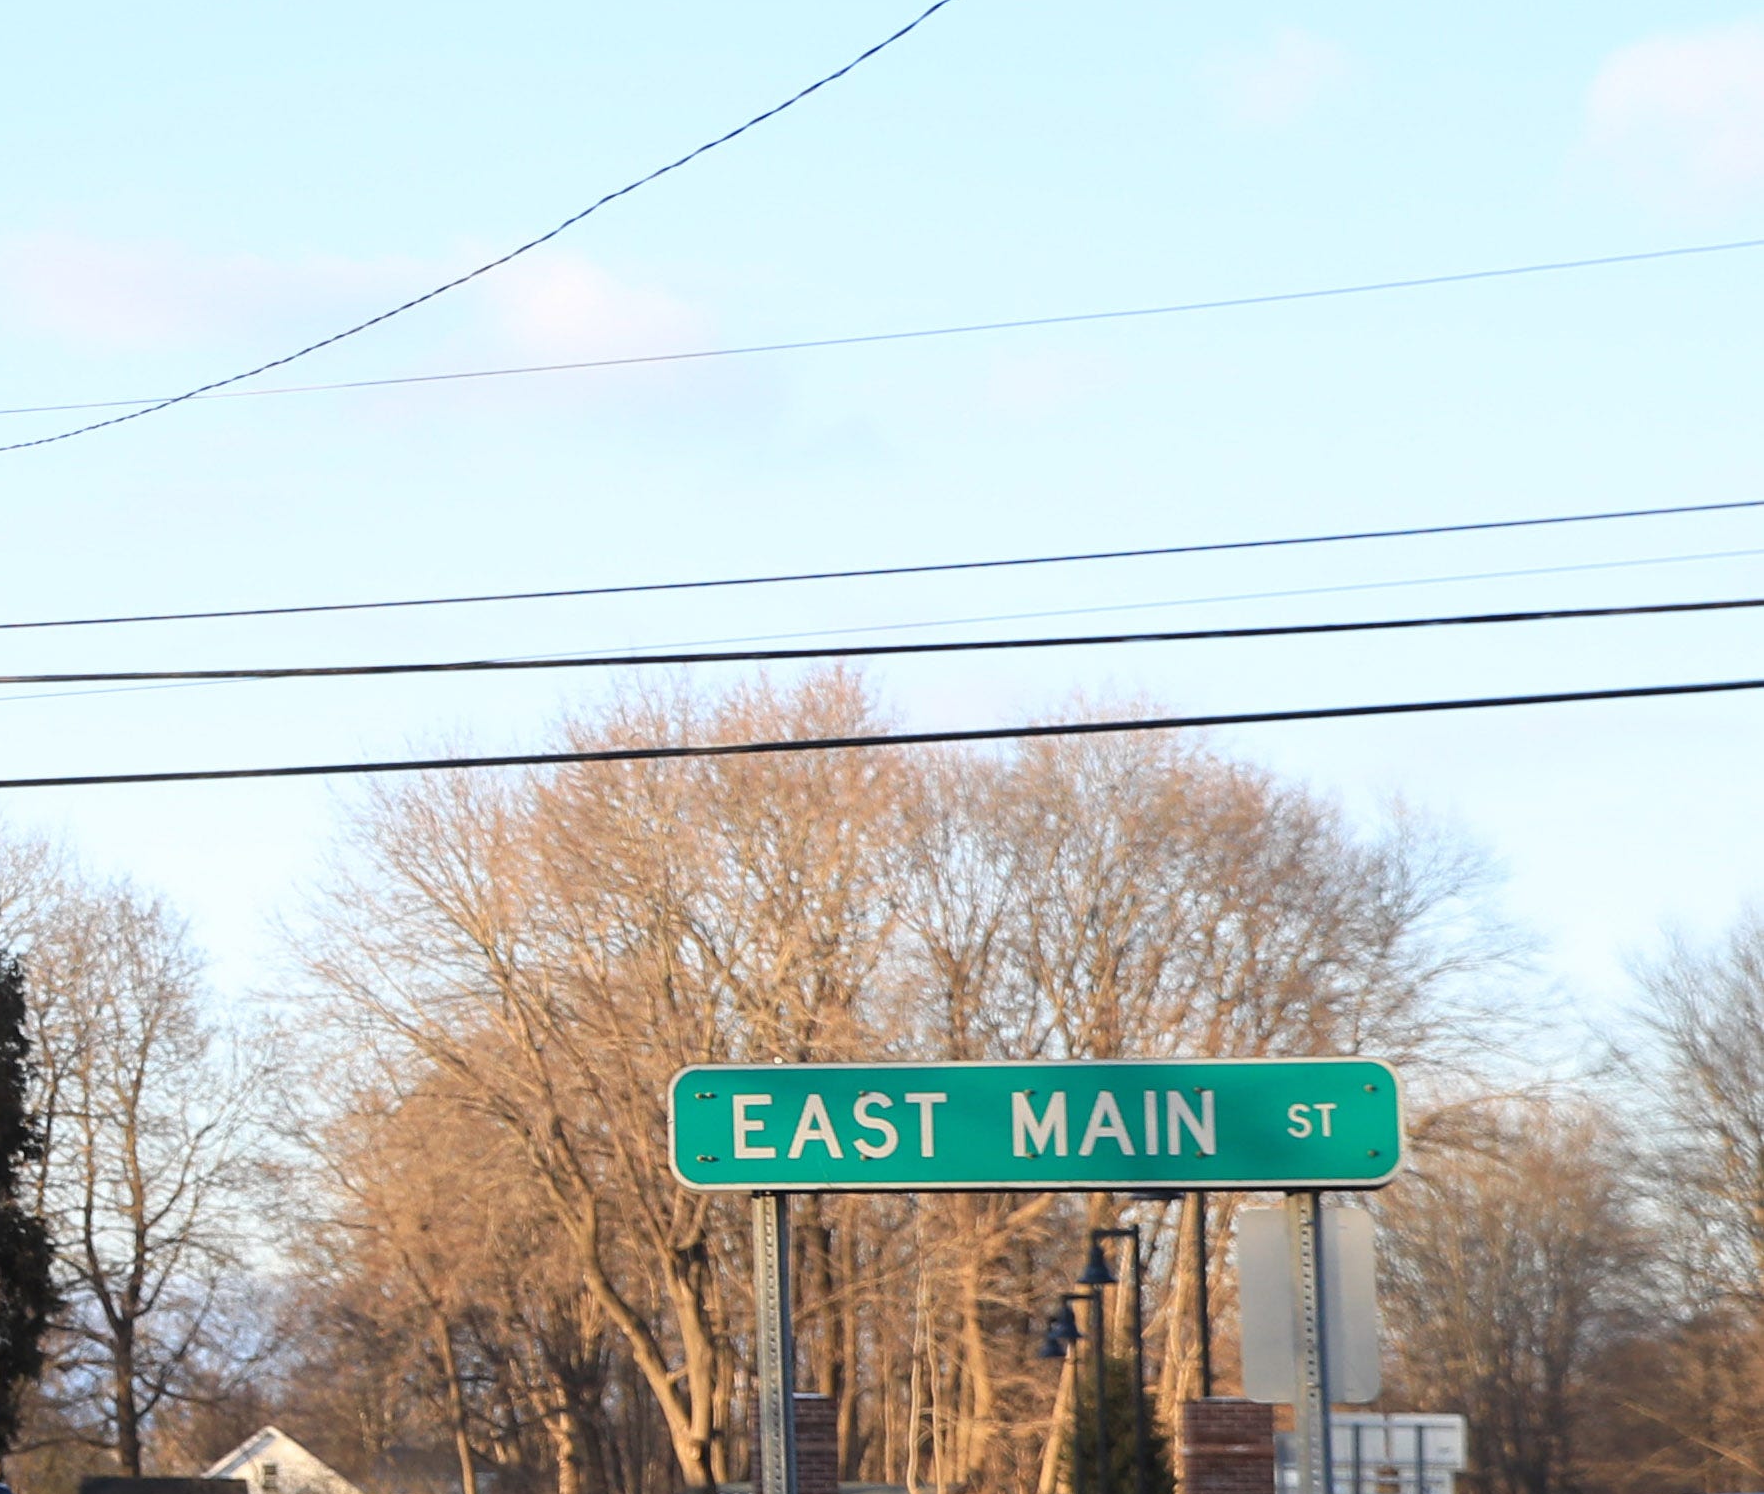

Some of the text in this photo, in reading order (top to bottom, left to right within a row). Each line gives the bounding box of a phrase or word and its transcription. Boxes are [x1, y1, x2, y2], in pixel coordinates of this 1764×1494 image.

[731, 1089, 1338, 1160] EAST MAIN ST
